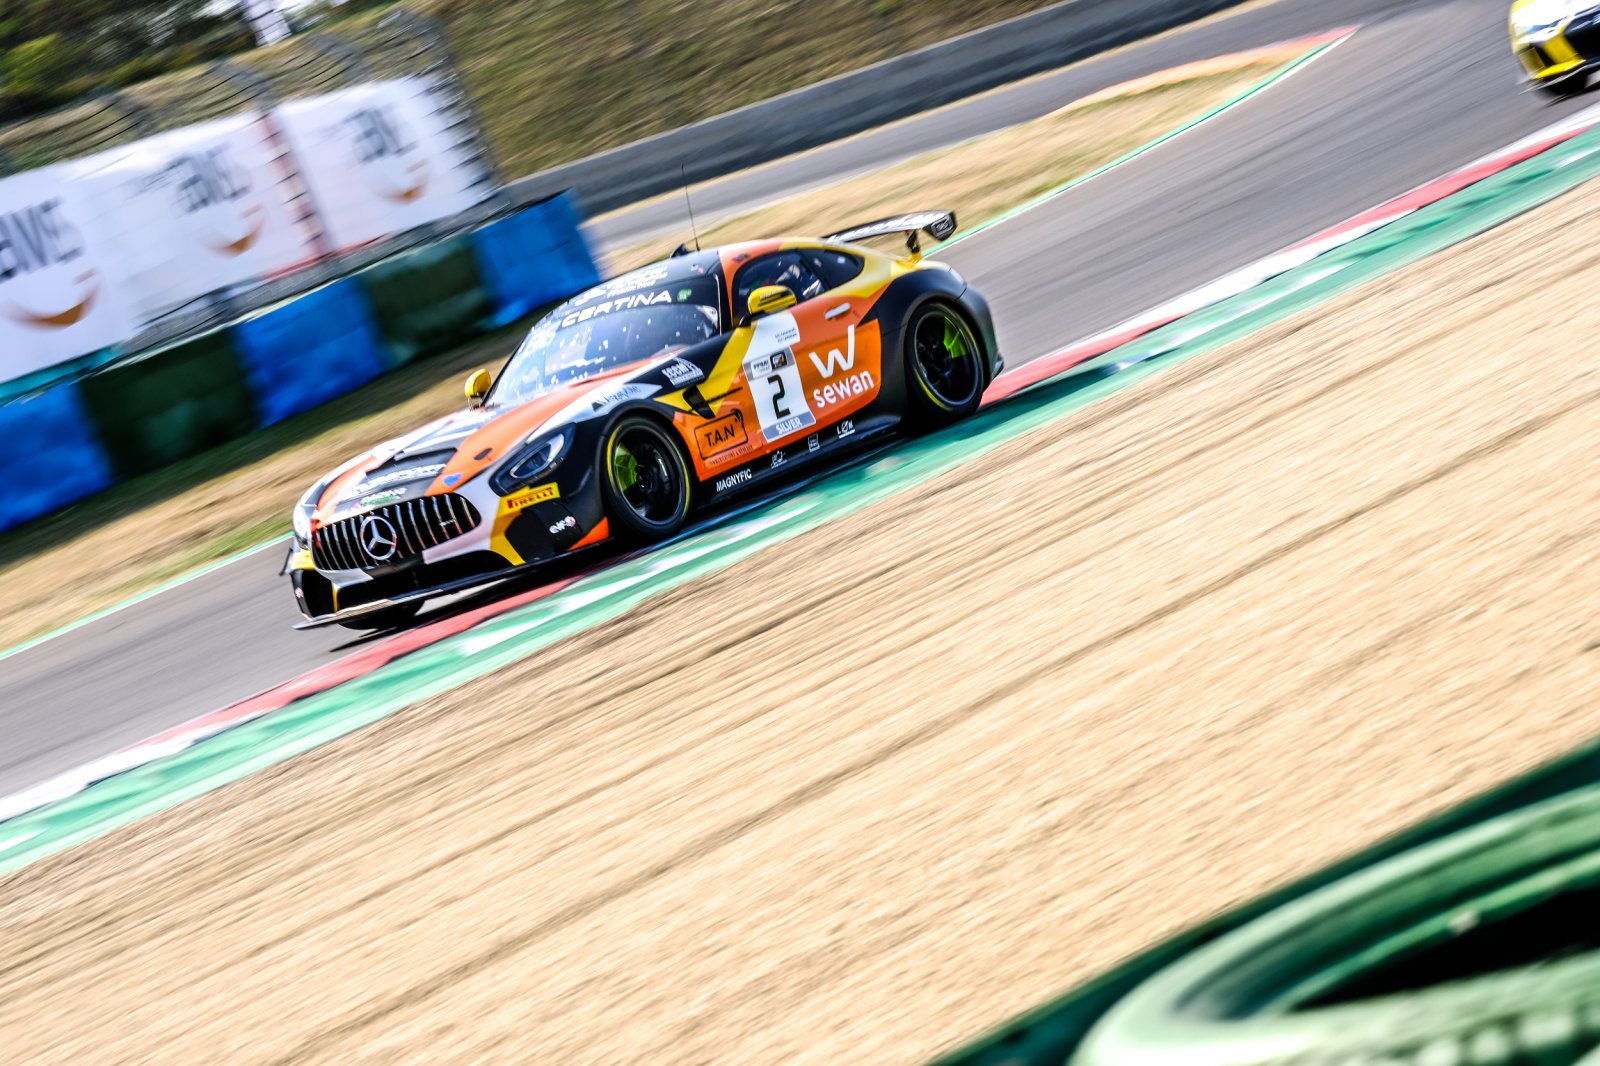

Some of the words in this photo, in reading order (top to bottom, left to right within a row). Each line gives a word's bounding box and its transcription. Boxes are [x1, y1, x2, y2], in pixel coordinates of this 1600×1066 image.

[561, 290, 672, 328] CERTINA
[767, 374, 791, 420] 2
[813, 370, 875, 408] sewan
[775, 416, 803, 435] SILVER
[716, 468, 753, 492] MAGNYFIC
[506, 487, 554, 509] PIRELLI
